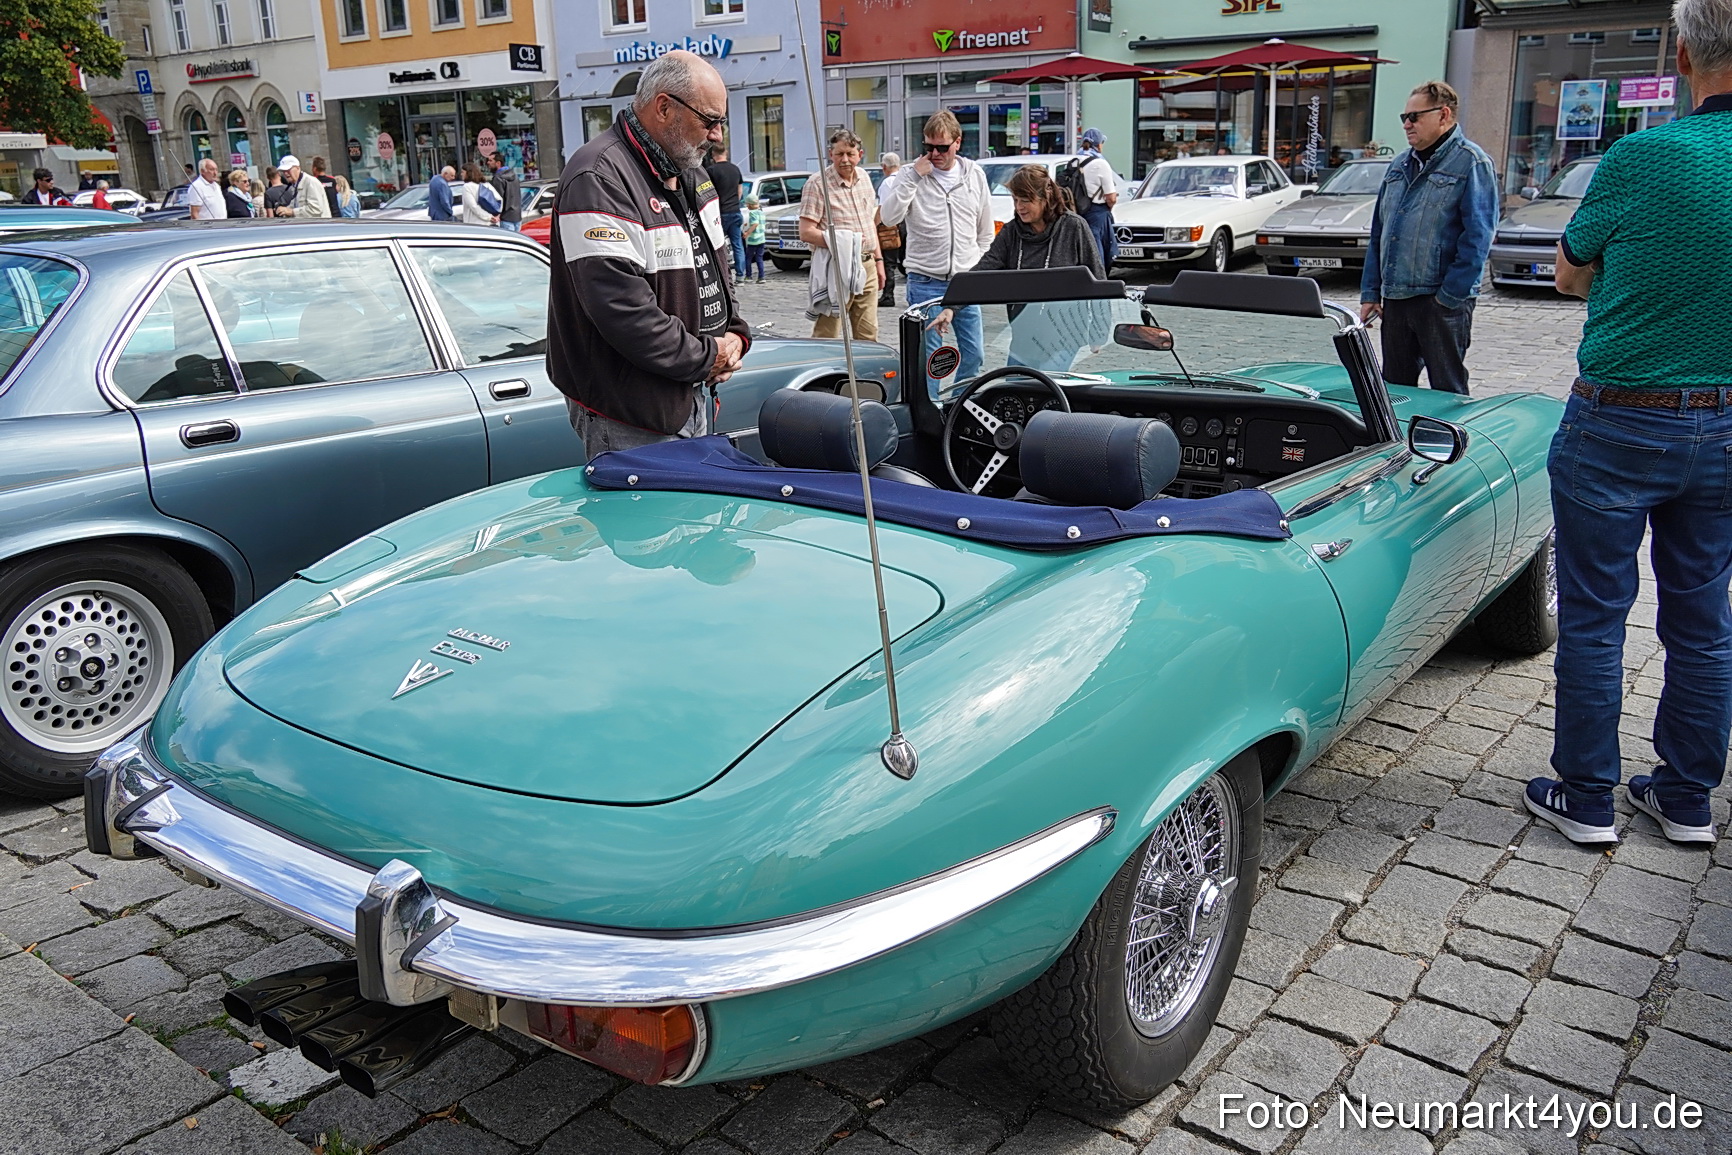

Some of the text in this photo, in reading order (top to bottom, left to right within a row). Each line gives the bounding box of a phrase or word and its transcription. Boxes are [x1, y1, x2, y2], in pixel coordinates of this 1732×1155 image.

[959, 28, 1030, 49] freenet
[518, 46, 536, 62] CB
[613, 34, 731, 63] mister lady
[440, 62, 460, 80] CB
[139, 72, 148, 92] P
[379, 140, 392, 150] 30%
[479, 136, 495, 147] 30%
[589, 230, 626, 241] NEXO
[1323, 259, 1337, 267] 83H
[1537, 265, 1548, 273] NM
[698, 281, 721, 299] DRINK
[704, 301, 722, 318] BEER
